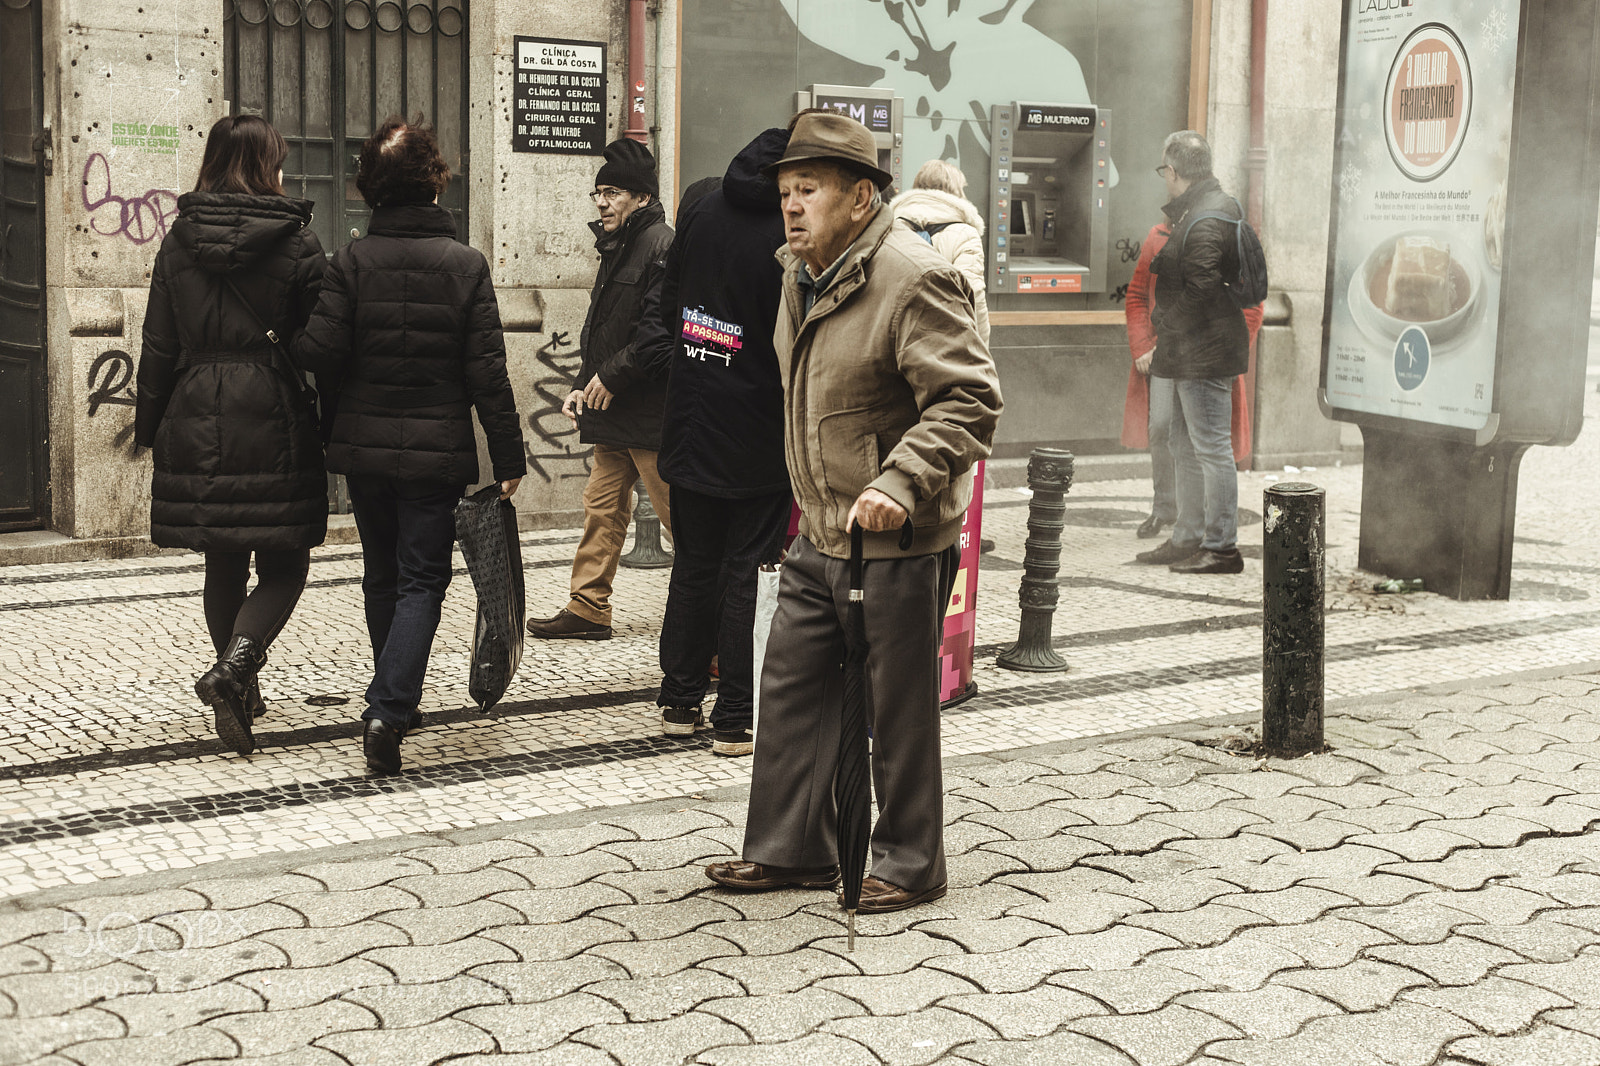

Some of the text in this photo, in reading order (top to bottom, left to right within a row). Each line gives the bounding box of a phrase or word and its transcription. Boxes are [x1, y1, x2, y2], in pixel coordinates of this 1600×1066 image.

[542, 47, 576, 57] CLÍNICA
[524, 57, 538, 65] DR.
[571, 60, 597, 68] COSTA
[519, 73, 600, 87] DR. HENRIQUE GIL DA COSTA
[528, 86, 593, 99] CLÍNICA GERAL
[519, 99, 600, 113] DR. FERNANDO GIL DA COSTA
[525, 114, 596, 124] CIRURGIA GERAL
[873, 109, 888, 119] MB
[1027, 114, 1089, 125] MB MULTIBANCO
[518, 124, 581, 138] DR. JORGE VALVERDE
[528, 139, 592, 149] OFTALMOLOGIA
[1380, 191, 1400, 200] Melhor
[1402, 190, 1437, 200] Francesinha
[1438, 190, 1445, 200] do
[687, 310, 742, 335] TÁ-SE TUDO
[683, 322, 734, 346] A PASSAR!
